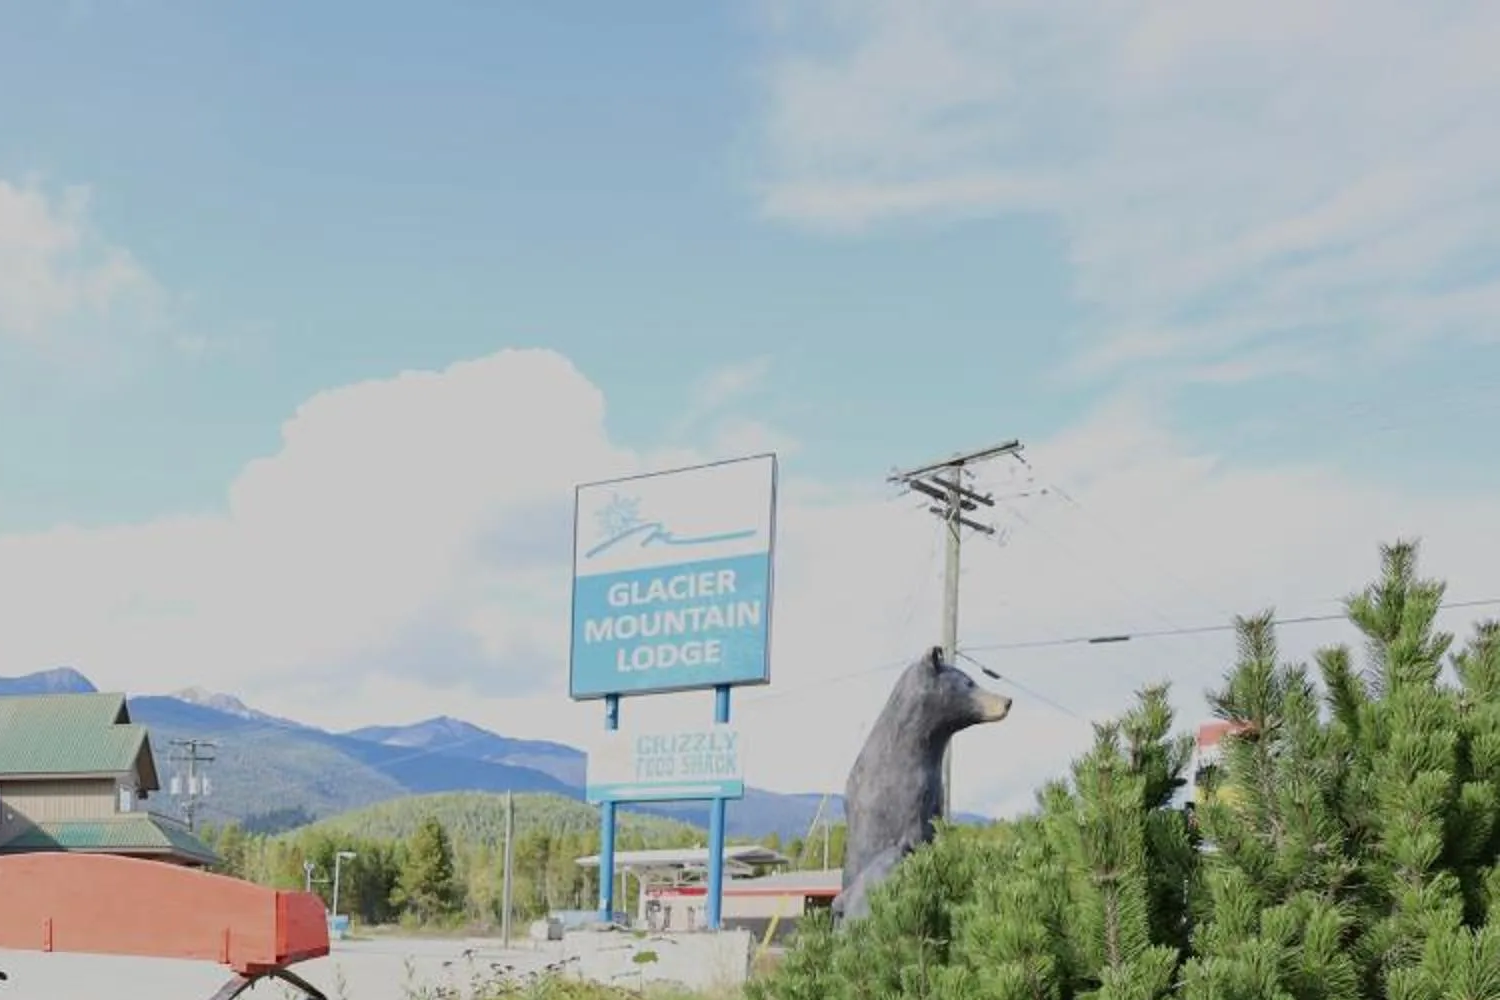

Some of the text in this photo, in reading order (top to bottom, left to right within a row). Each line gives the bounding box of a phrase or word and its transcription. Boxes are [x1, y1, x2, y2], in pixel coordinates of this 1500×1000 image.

[608, 569, 736, 607] GLACIER
[584, 602, 760, 644] MOUNTAIN
[617, 640, 721, 671] LODGE
[635, 733, 738, 755] GRIZZLY
